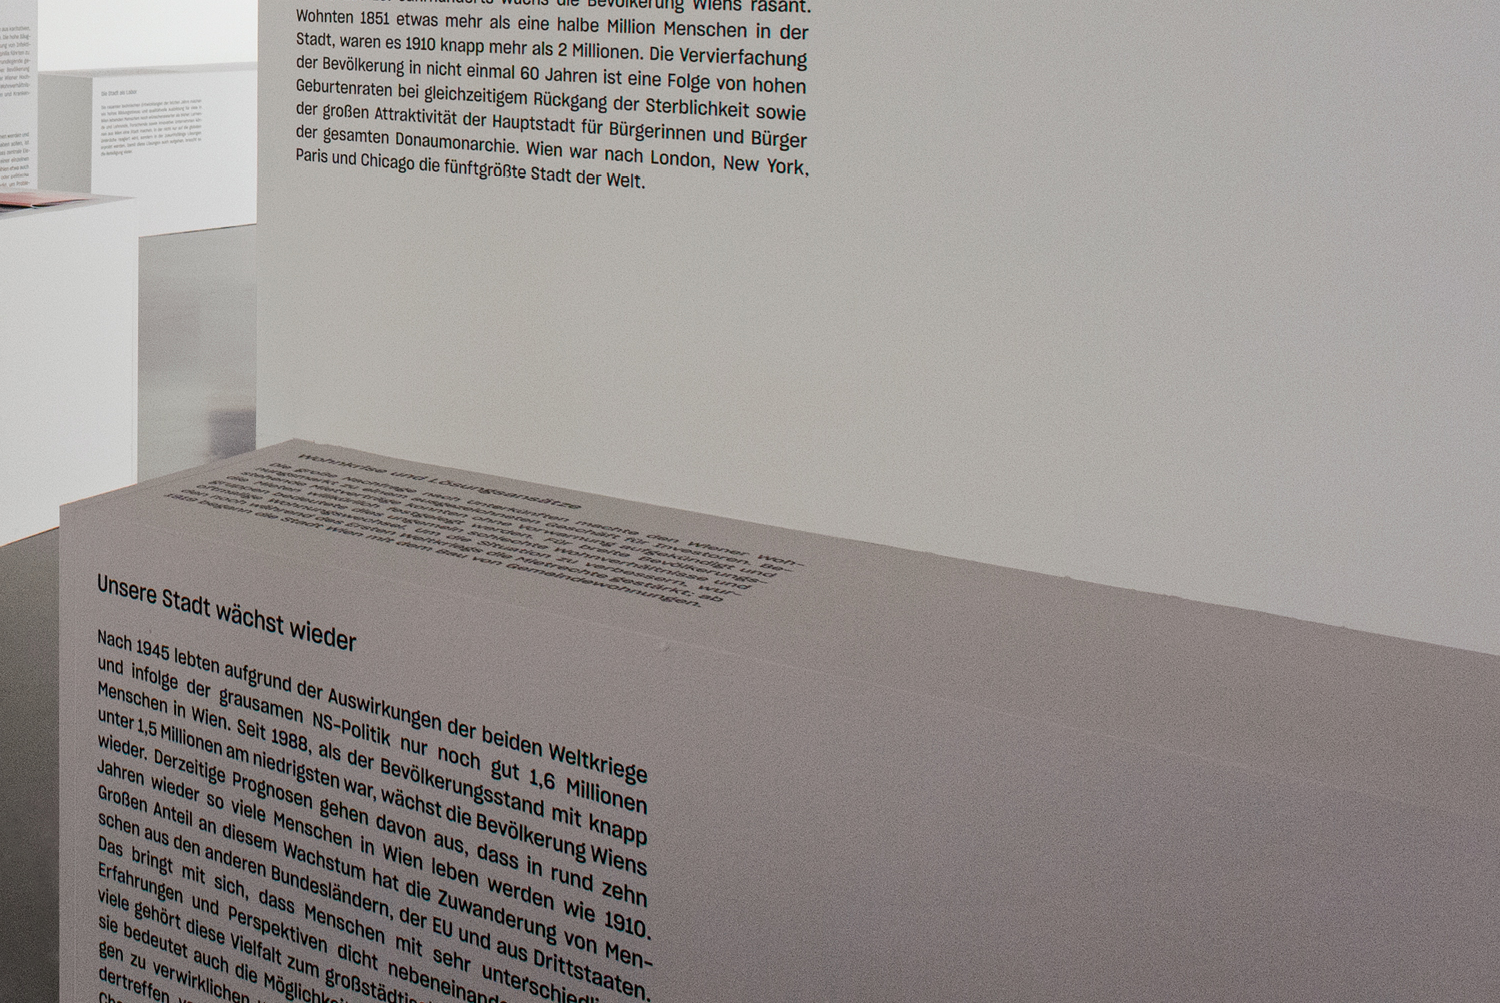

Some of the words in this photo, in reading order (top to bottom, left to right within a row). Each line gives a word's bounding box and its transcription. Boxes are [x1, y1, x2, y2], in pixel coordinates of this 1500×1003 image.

[97, 573, 157, 604] Unsere
[162, 588, 210, 618] Stadt
[215, 602, 284, 635] wächst
[289, 620, 357, 652] wieder
[97, 628, 132, 652] Nach
[136, 638, 170, 661] 1945
[174, 647, 220, 674] lebten
[224, 663, 292, 693] aufgrund
[296, 679, 324, 700] der
[327, 687, 442, 731] Auswirkungen
[447, 717, 477, 739] der
[482, 724, 542, 757] beiden
[548, 742, 648, 786] Weltkriege
